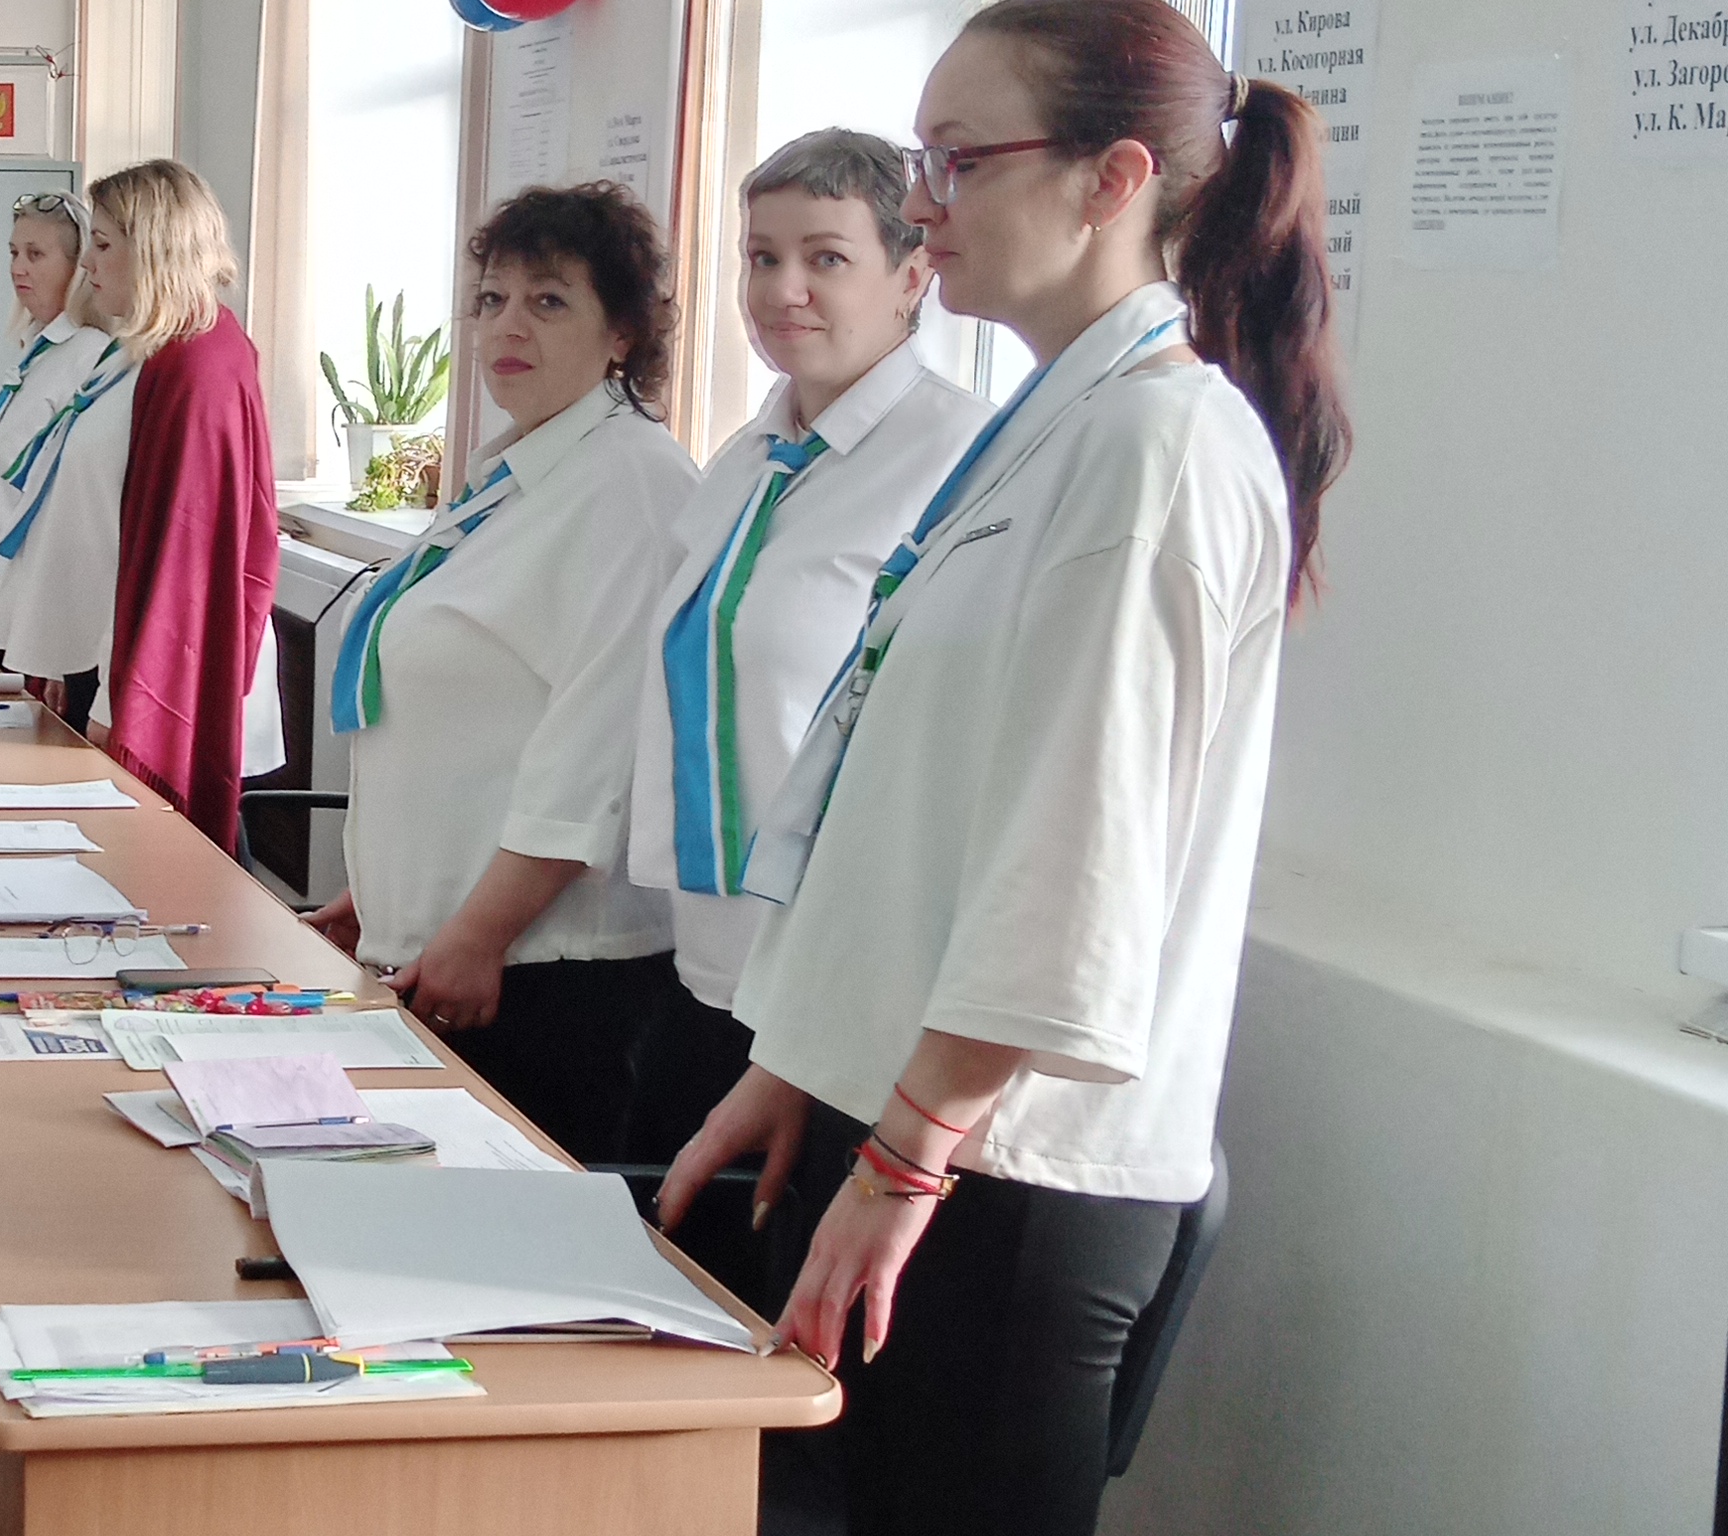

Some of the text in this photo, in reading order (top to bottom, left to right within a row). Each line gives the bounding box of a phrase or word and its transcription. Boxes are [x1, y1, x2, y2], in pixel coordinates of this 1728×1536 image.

[1297, 10, 1350, 38] Кирова
[1629, 25, 1658, 53] ул.
[1281, 48, 1364, 74] Косогорная
[1632, 69, 1661, 96] ул.
[1633, 101, 1728, 139] ул. К. Ма
